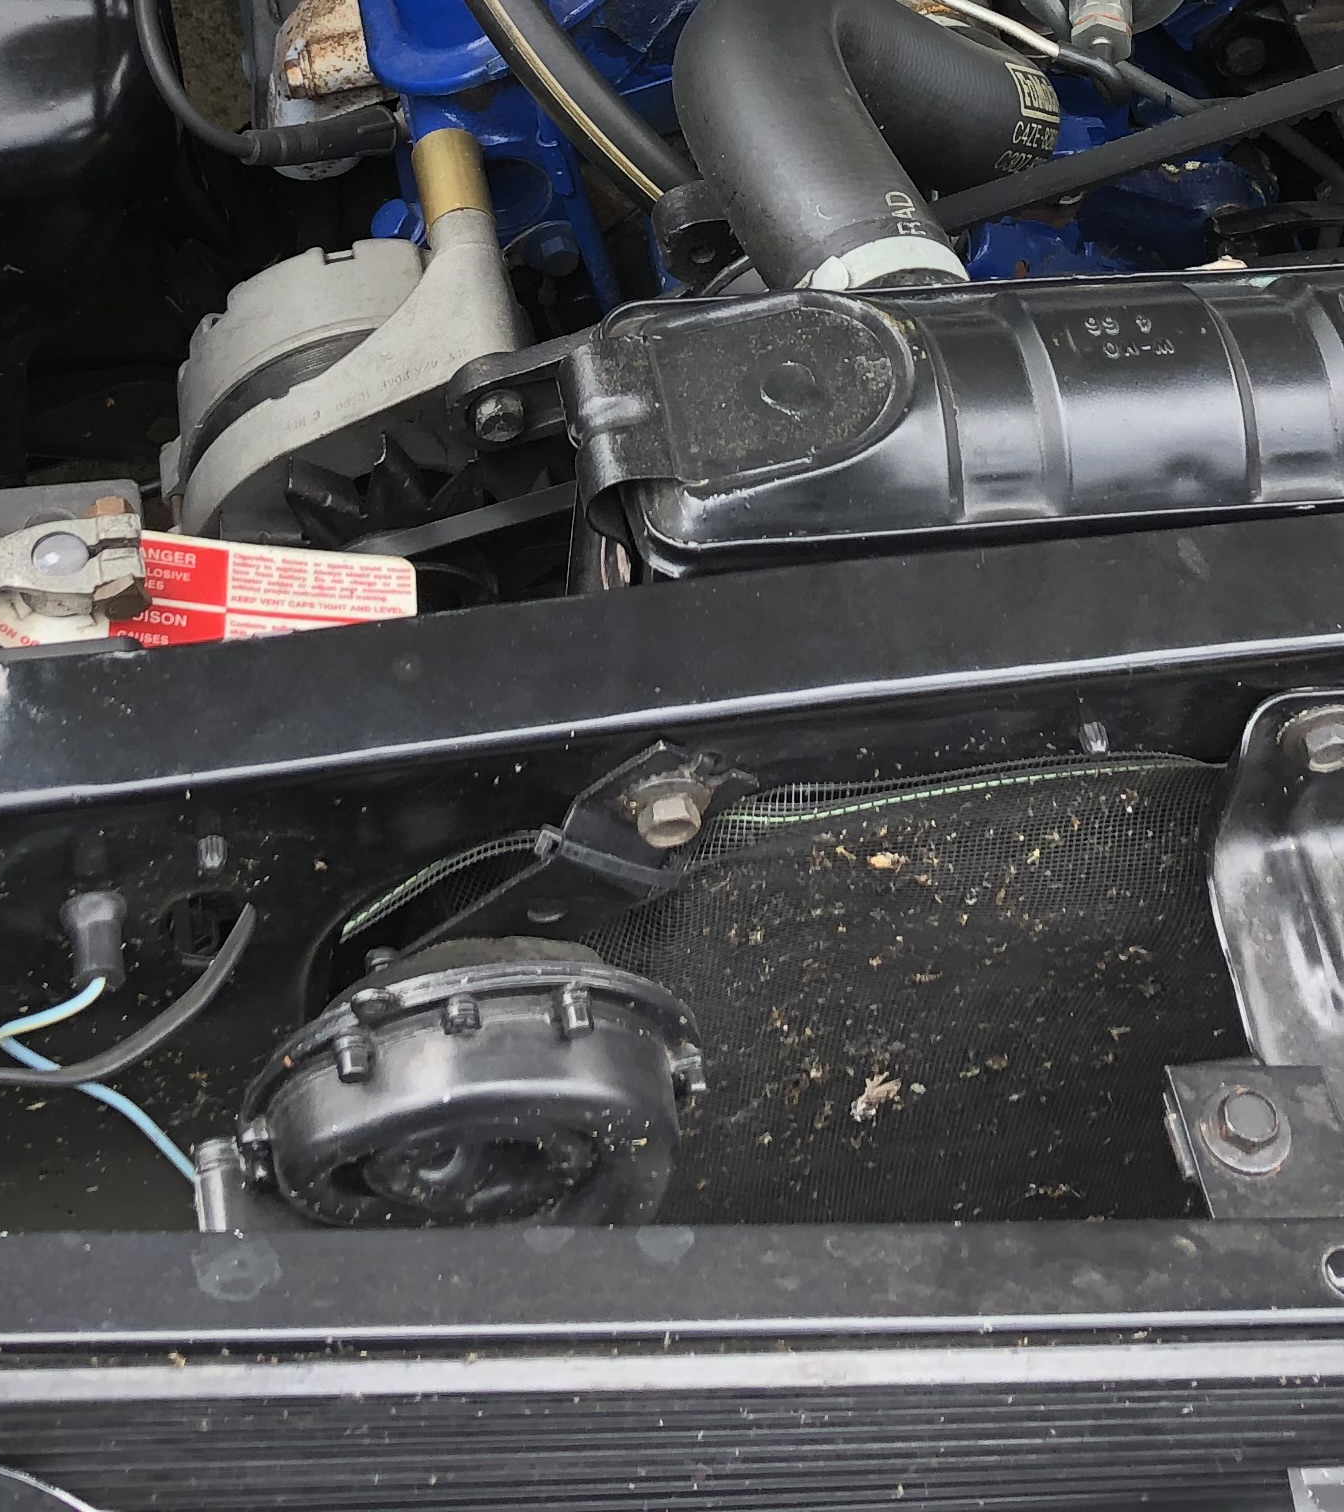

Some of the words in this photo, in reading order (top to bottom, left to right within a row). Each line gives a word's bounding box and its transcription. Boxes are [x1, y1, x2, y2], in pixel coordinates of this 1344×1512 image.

[230, 595, 258, 604] KEEP
[260, 598, 285, 607] VENT
[287, 600, 316, 609] CAPS
[318, 602, 348, 611] TIGHT
[350, 604, 372, 613] AND
